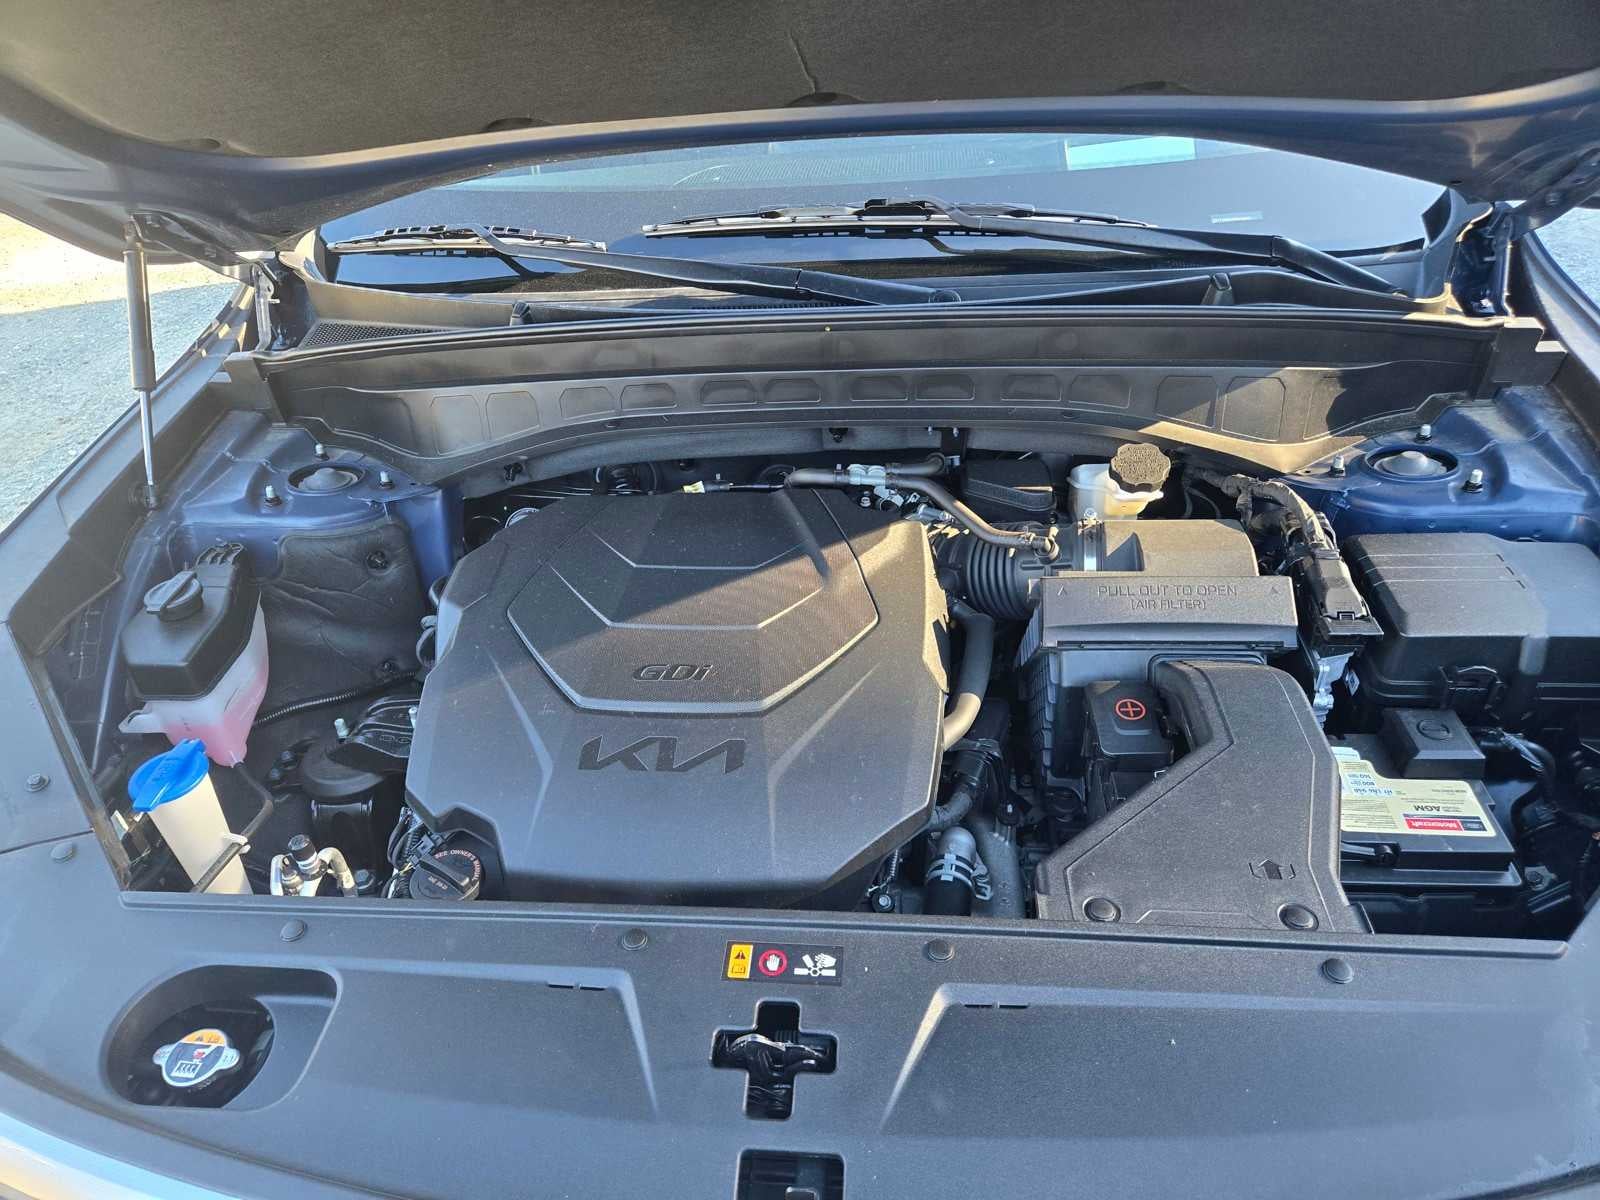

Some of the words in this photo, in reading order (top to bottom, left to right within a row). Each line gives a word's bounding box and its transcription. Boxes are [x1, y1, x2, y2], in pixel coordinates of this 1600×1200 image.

[1098, 585, 1135, 597] PULL
[1139, 585, 1169, 597] OUT
[1174, 585, 1193, 597] TO
[1196, 585, 1238, 597] OPEN
[632, 664, 713, 682] GDi
[578, 735, 747, 774] KIA
[1414, 804, 1441, 812] AGM
